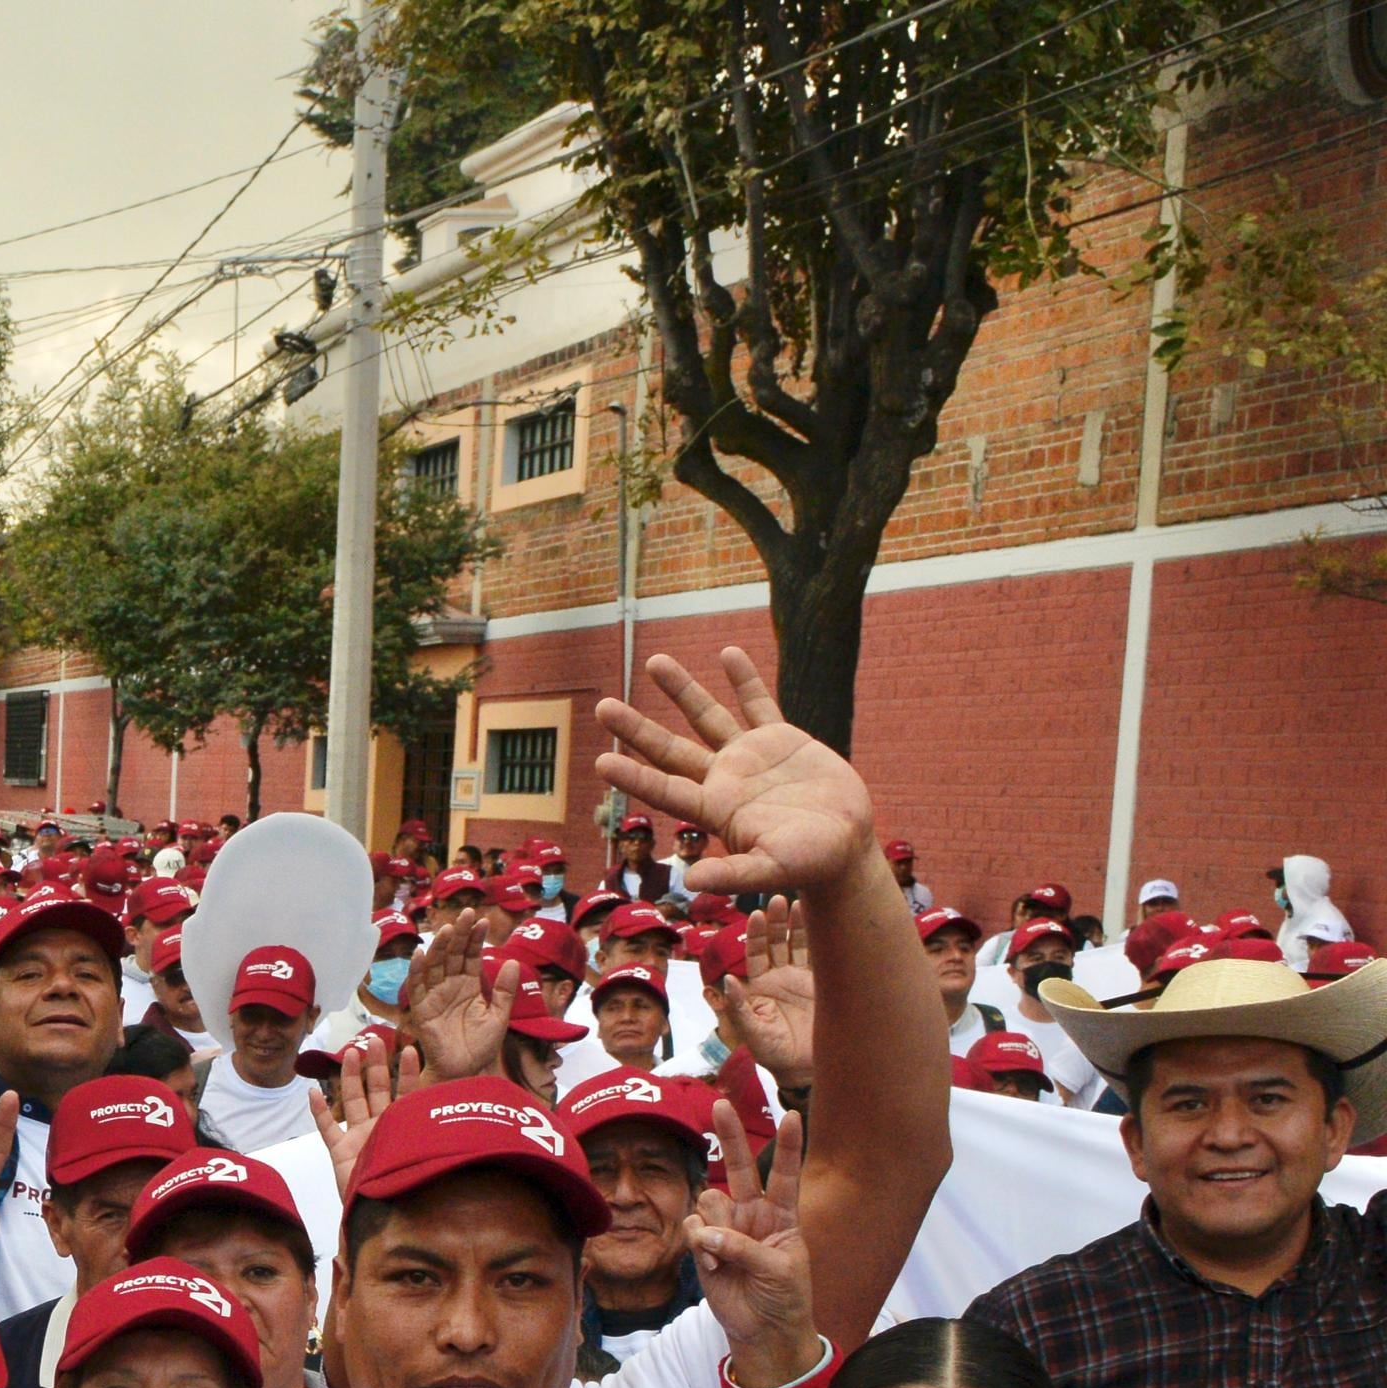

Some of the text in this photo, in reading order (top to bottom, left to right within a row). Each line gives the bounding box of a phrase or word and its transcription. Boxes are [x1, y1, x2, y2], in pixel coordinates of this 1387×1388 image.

[247, 960, 293, 980] PROYECTO 21
[633, 967, 651, 980] 21
[90, 1096, 174, 1128] PROYECTO 21
[571, 1078, 661, 1113] PROYECTO 21
[429, 1102, 565, 1157] PROYECTO 21
[151, 1157, 248, 1199] PROYECTO 21
[113, 1274, 231, 1318] PROYECTO 21
